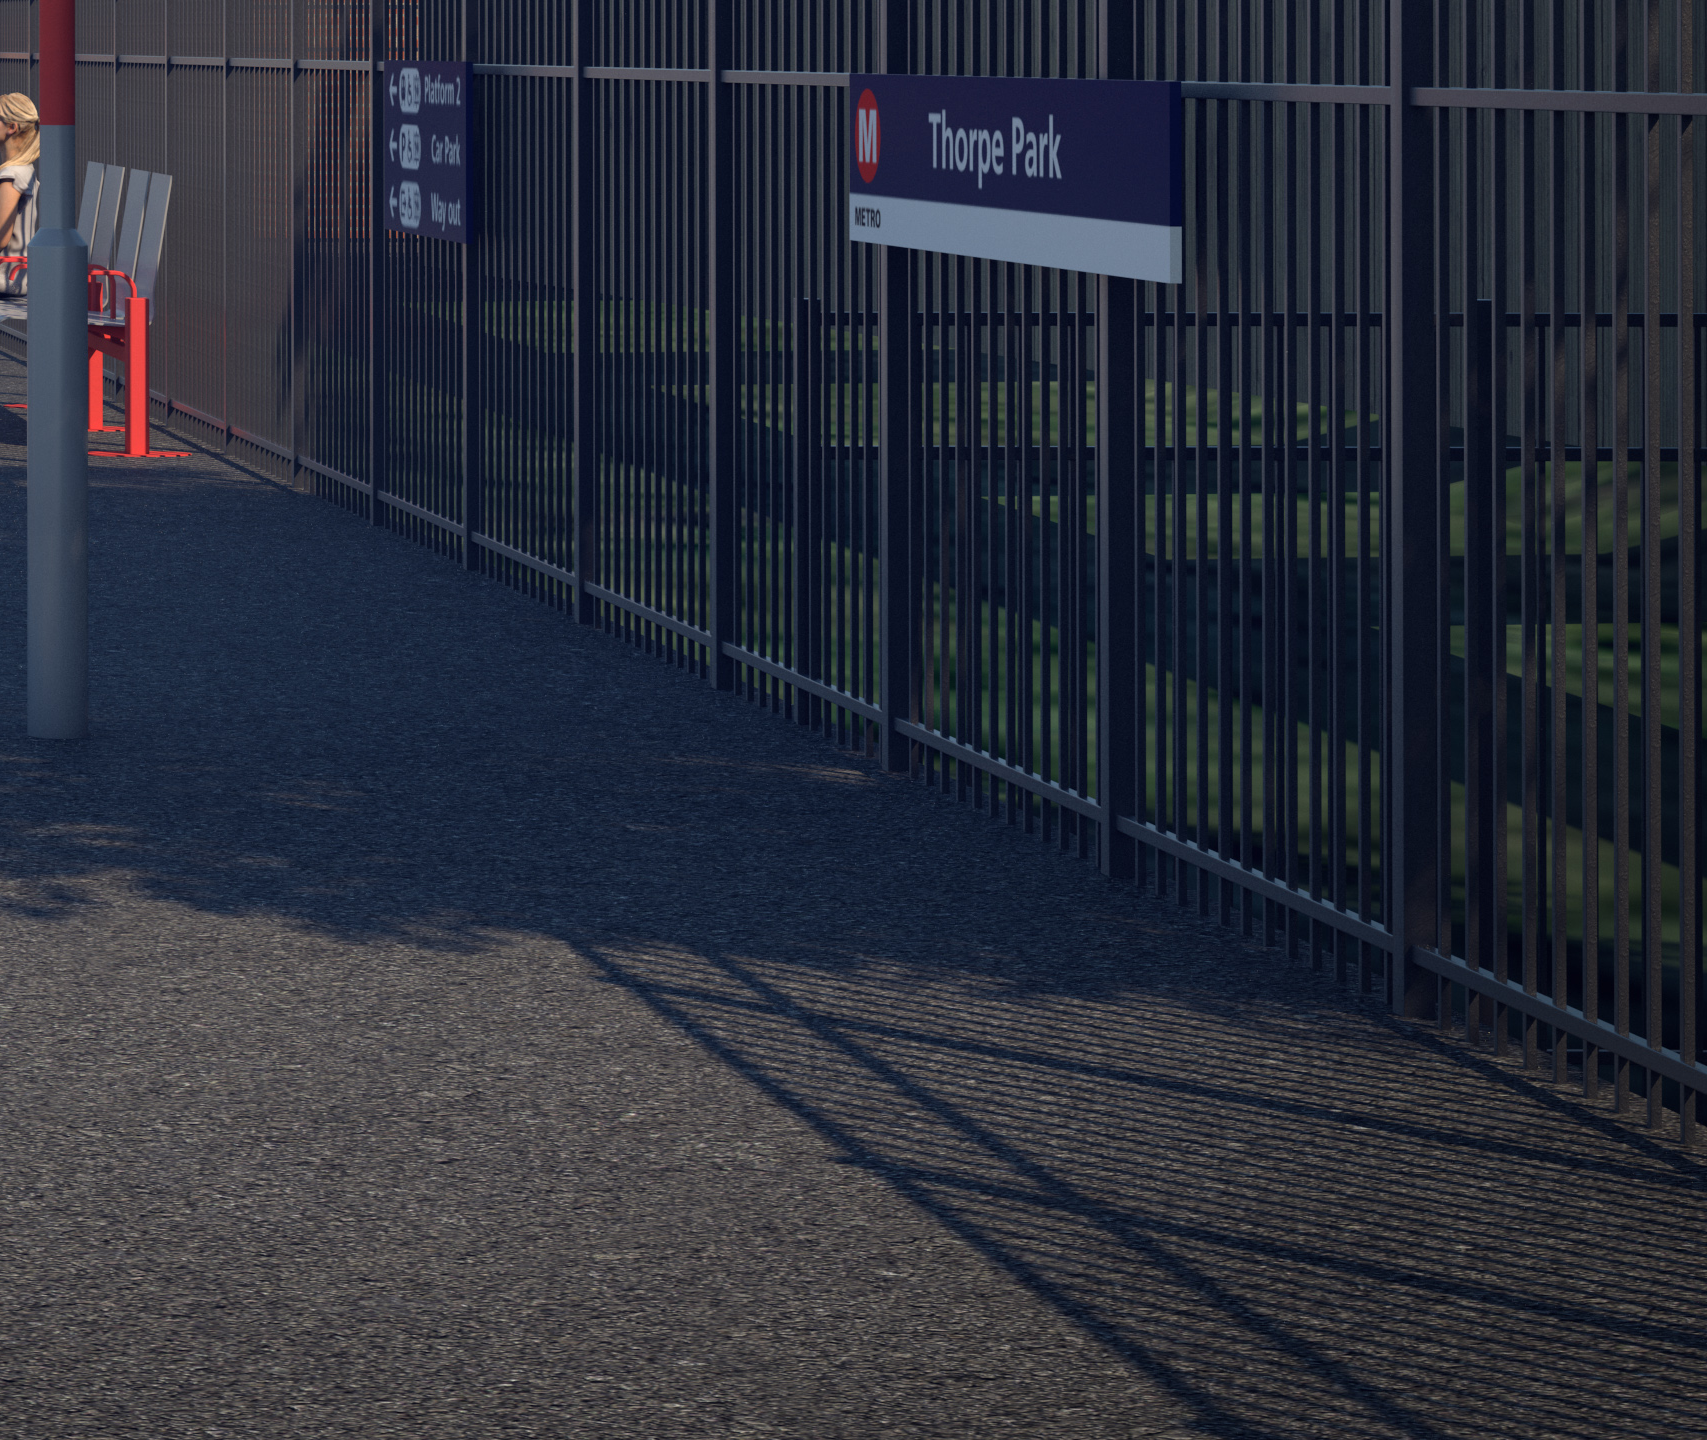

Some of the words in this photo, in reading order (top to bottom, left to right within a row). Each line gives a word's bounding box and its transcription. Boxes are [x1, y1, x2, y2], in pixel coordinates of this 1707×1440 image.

[424, 74, 454, 105] Platform
[456, 76, 461, 106] 2
[431, 134, 443, 164] Car
[445, 134, 461, 166] Park
[928, 109, 1005, 190] Thorpe
[1011, 114, 1062, 180] Park
[431, 192, 445, 232] Way
[448, 199, 461, 226] out
[854, 206, 881, 229] METRO
